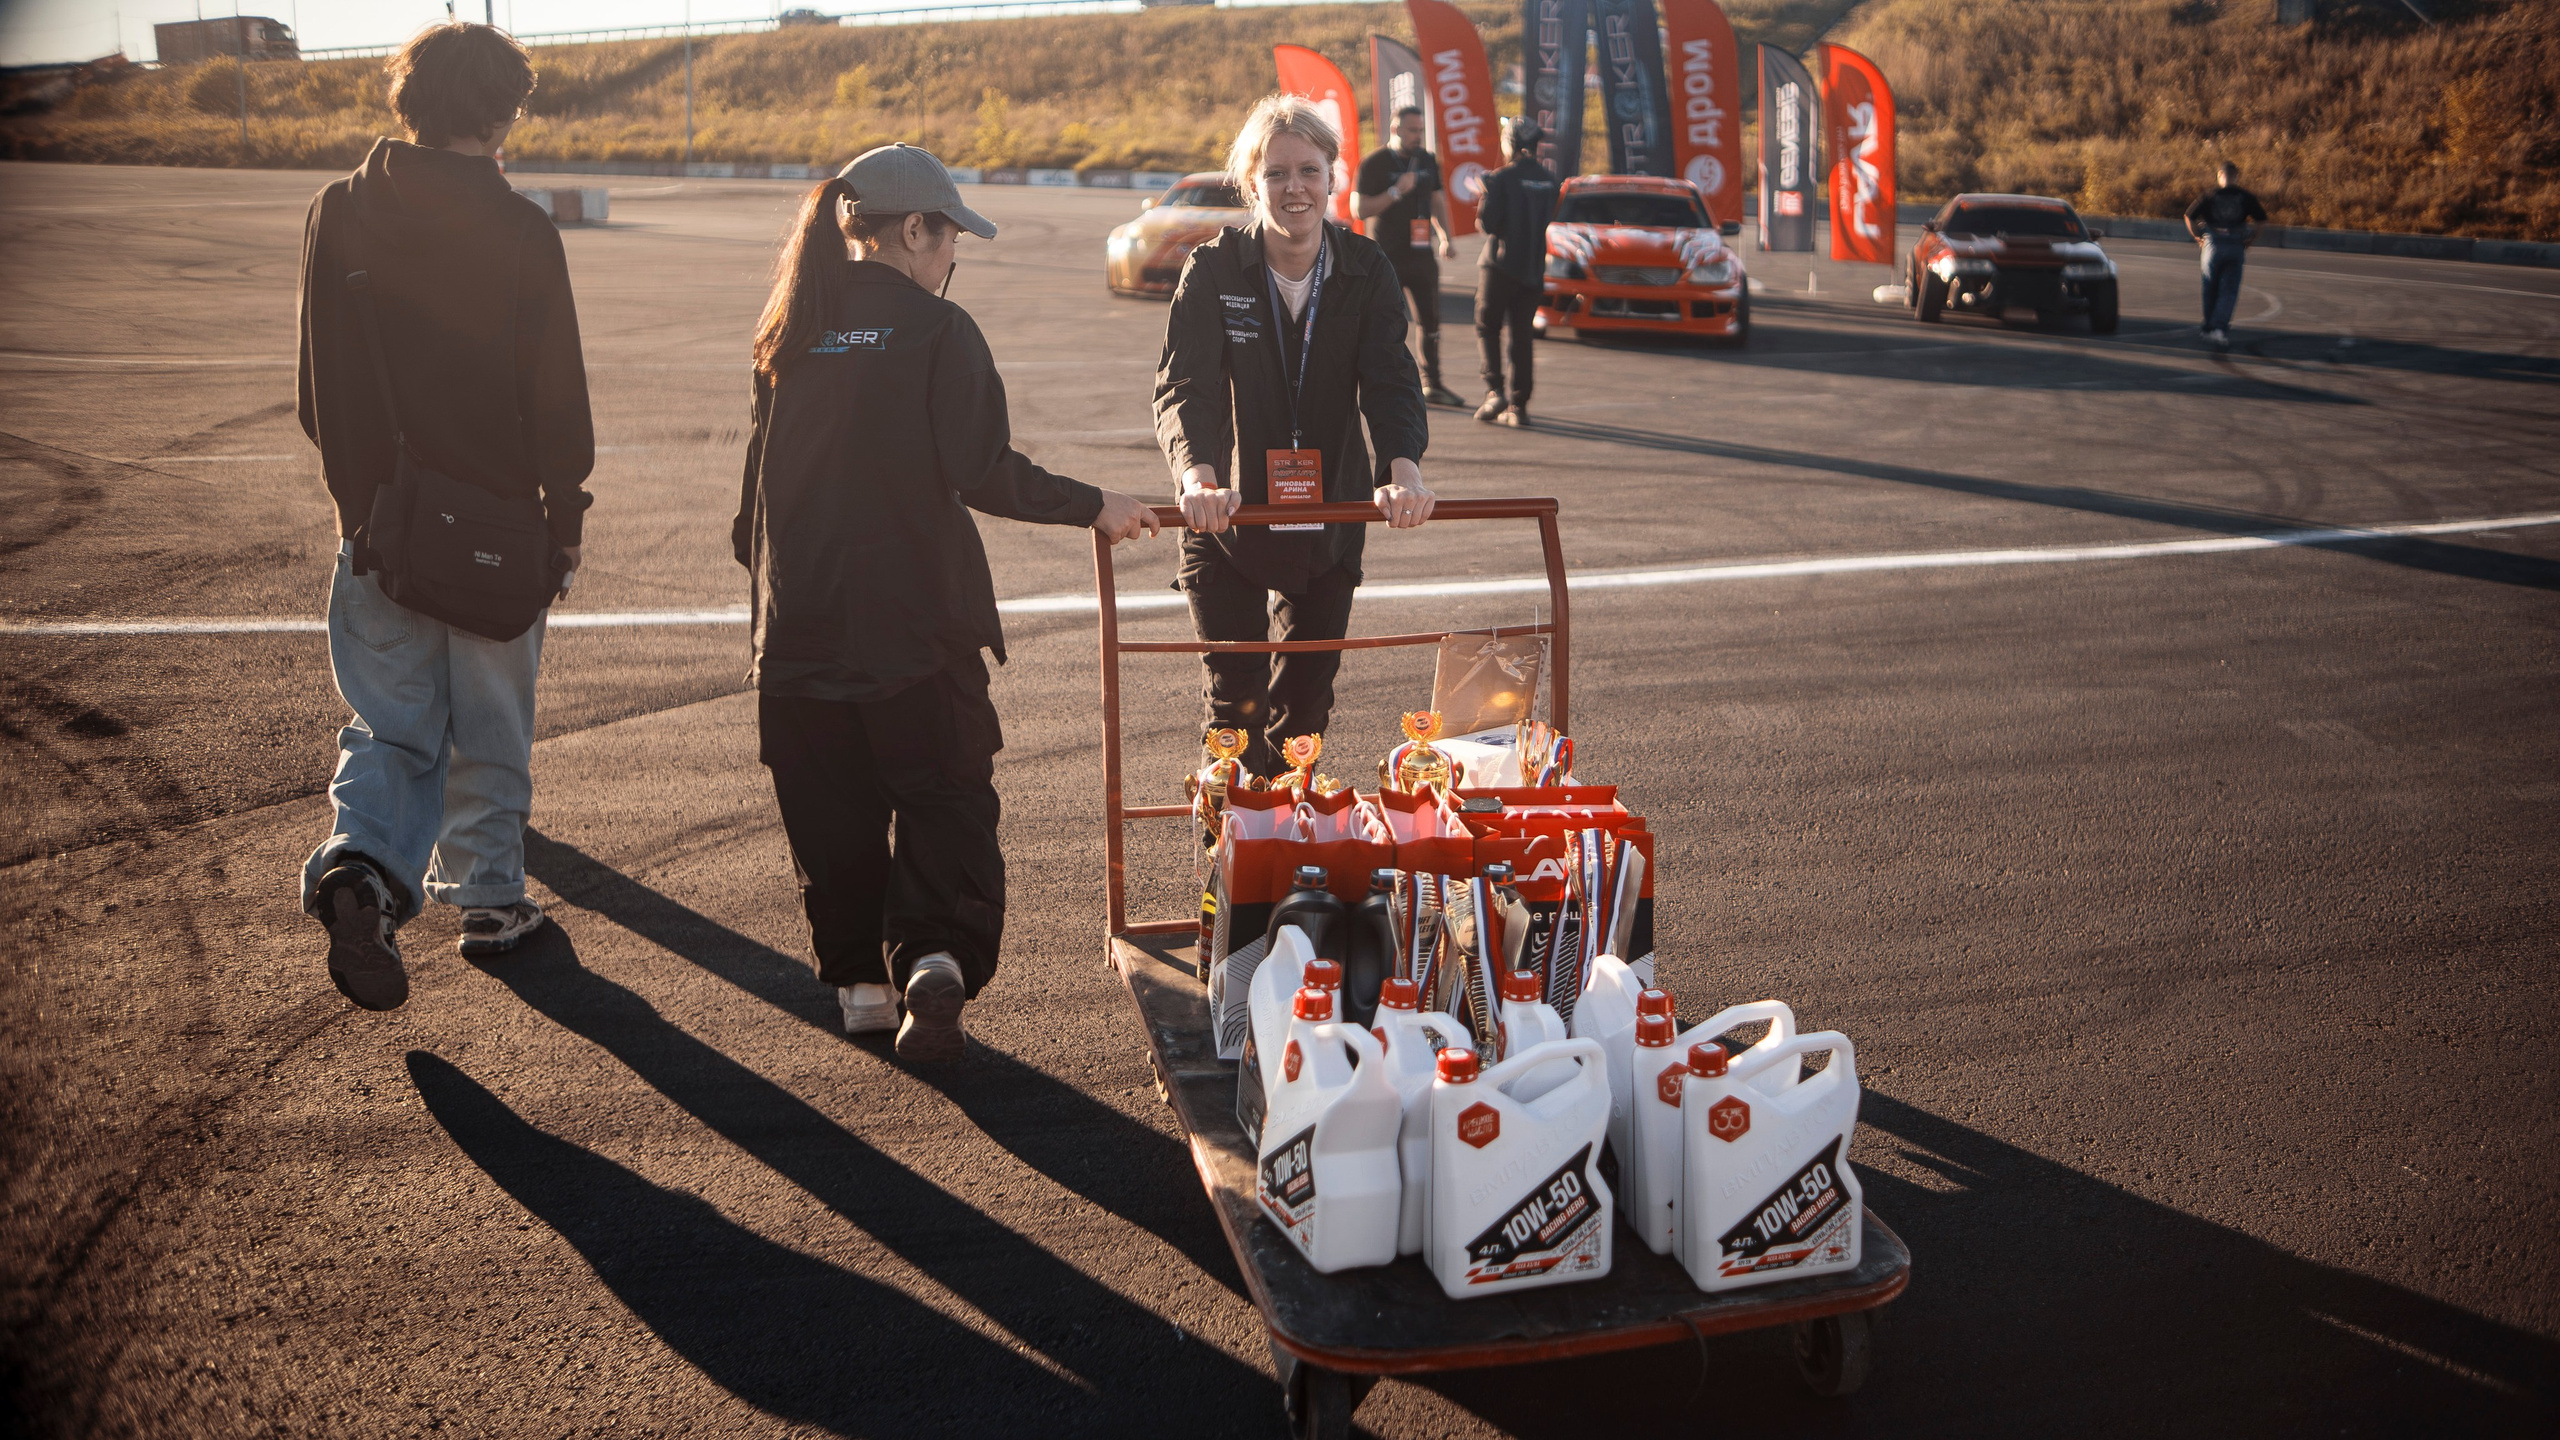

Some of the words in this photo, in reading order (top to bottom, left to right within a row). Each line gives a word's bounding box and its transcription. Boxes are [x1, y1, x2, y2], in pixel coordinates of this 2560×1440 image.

[1273, 1140, 1308, 1187] 10W-50
[1501, 1171, 1581, 1249] 10W-50
[1540, 1212, 1566, 1239] RACING
[1565, 1196, 1585, 1217] HERO
[1754, 1163, 1832, 1241] 10W-50
[1791, 1205, 1817, 1231] RACING
[1817, 1188, 1836, 1210] HERO
